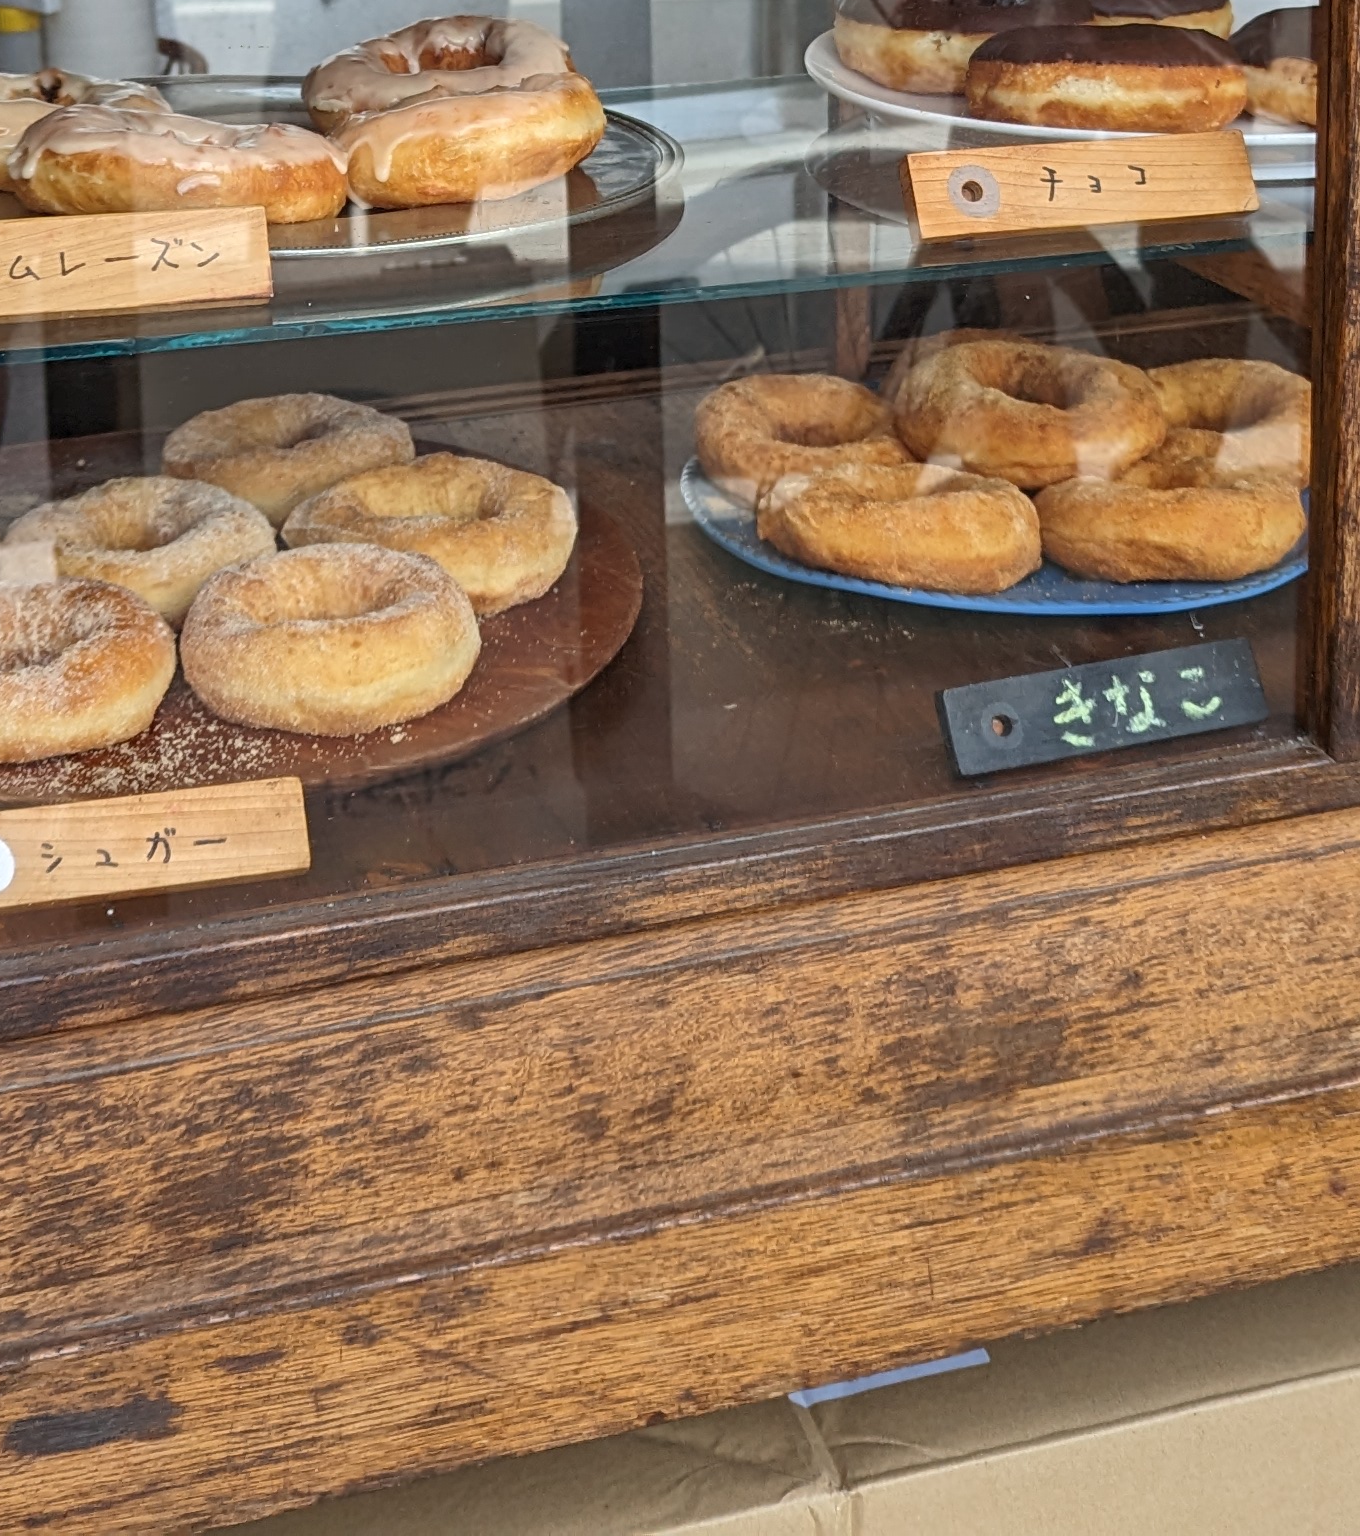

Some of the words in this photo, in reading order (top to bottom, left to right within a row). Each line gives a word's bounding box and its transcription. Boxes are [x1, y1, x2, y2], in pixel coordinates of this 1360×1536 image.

[1039, 164, 1147, 202] チョコ
[1053, 667, 1220, 747] きなこ
[40, 827, 228, 874] シュガー
